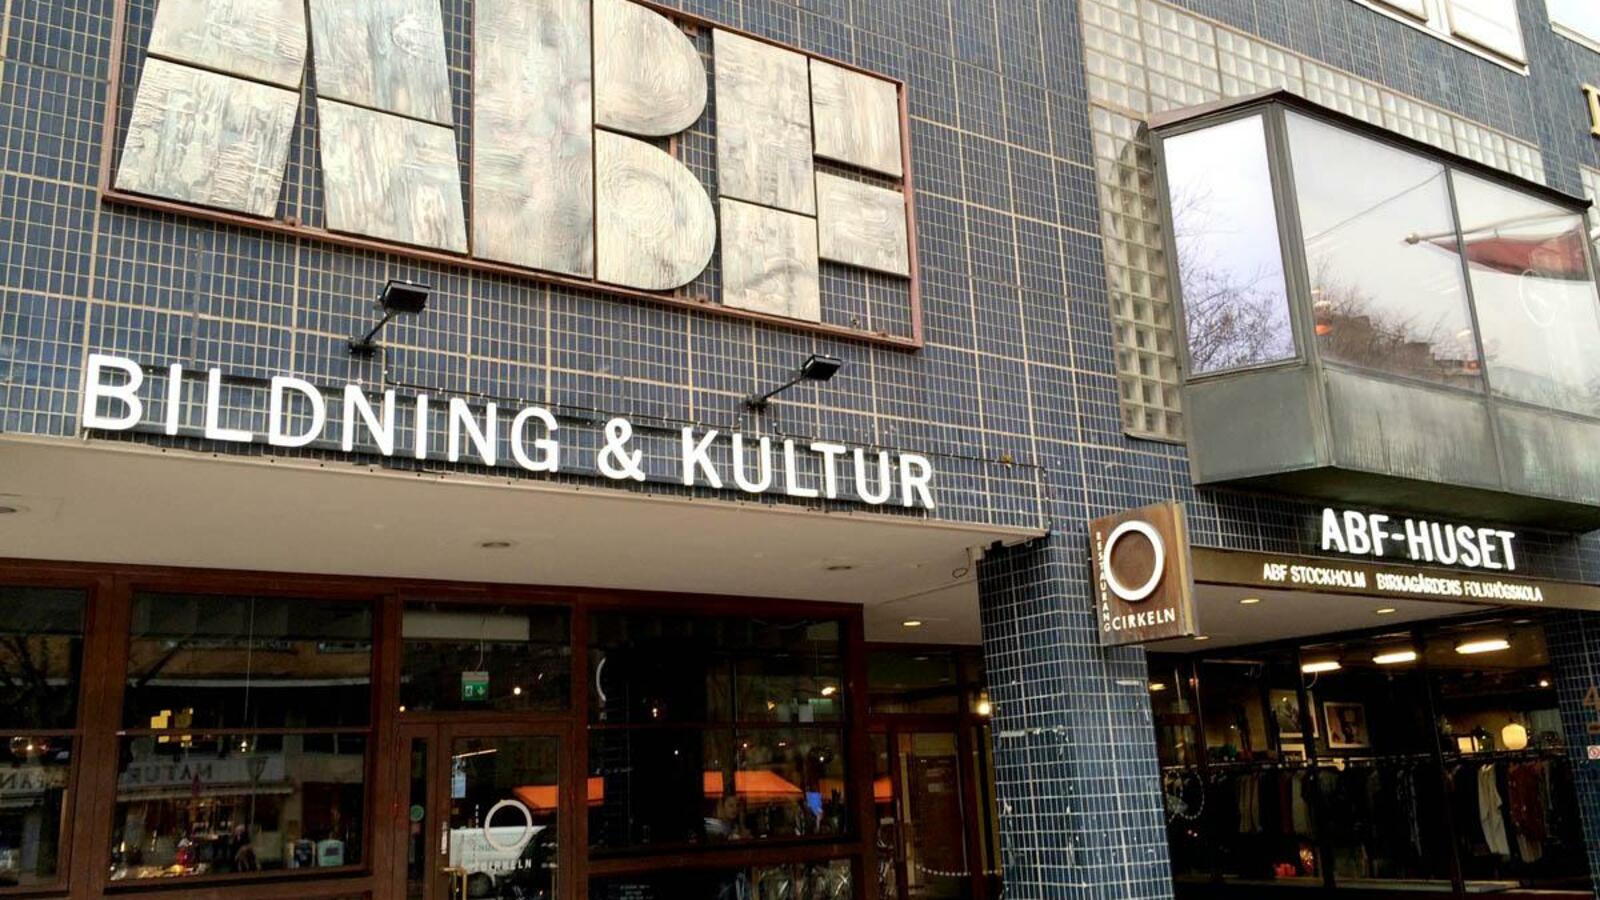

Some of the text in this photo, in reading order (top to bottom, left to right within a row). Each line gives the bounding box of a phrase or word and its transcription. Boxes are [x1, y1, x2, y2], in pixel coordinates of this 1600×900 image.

[83, 353, 935, 509] BILDNING & KULTUR
[1321, 507, 1516, 571] ABF-HUSET
[1263, 562, 1288, 582] ABF
[1290, 565, 1366, 588] STOCKHOLM
[1375, 573, 1463, 596] BIRKAGÅRDENS
[1112, 607, 1176, 631] CIRKELN
